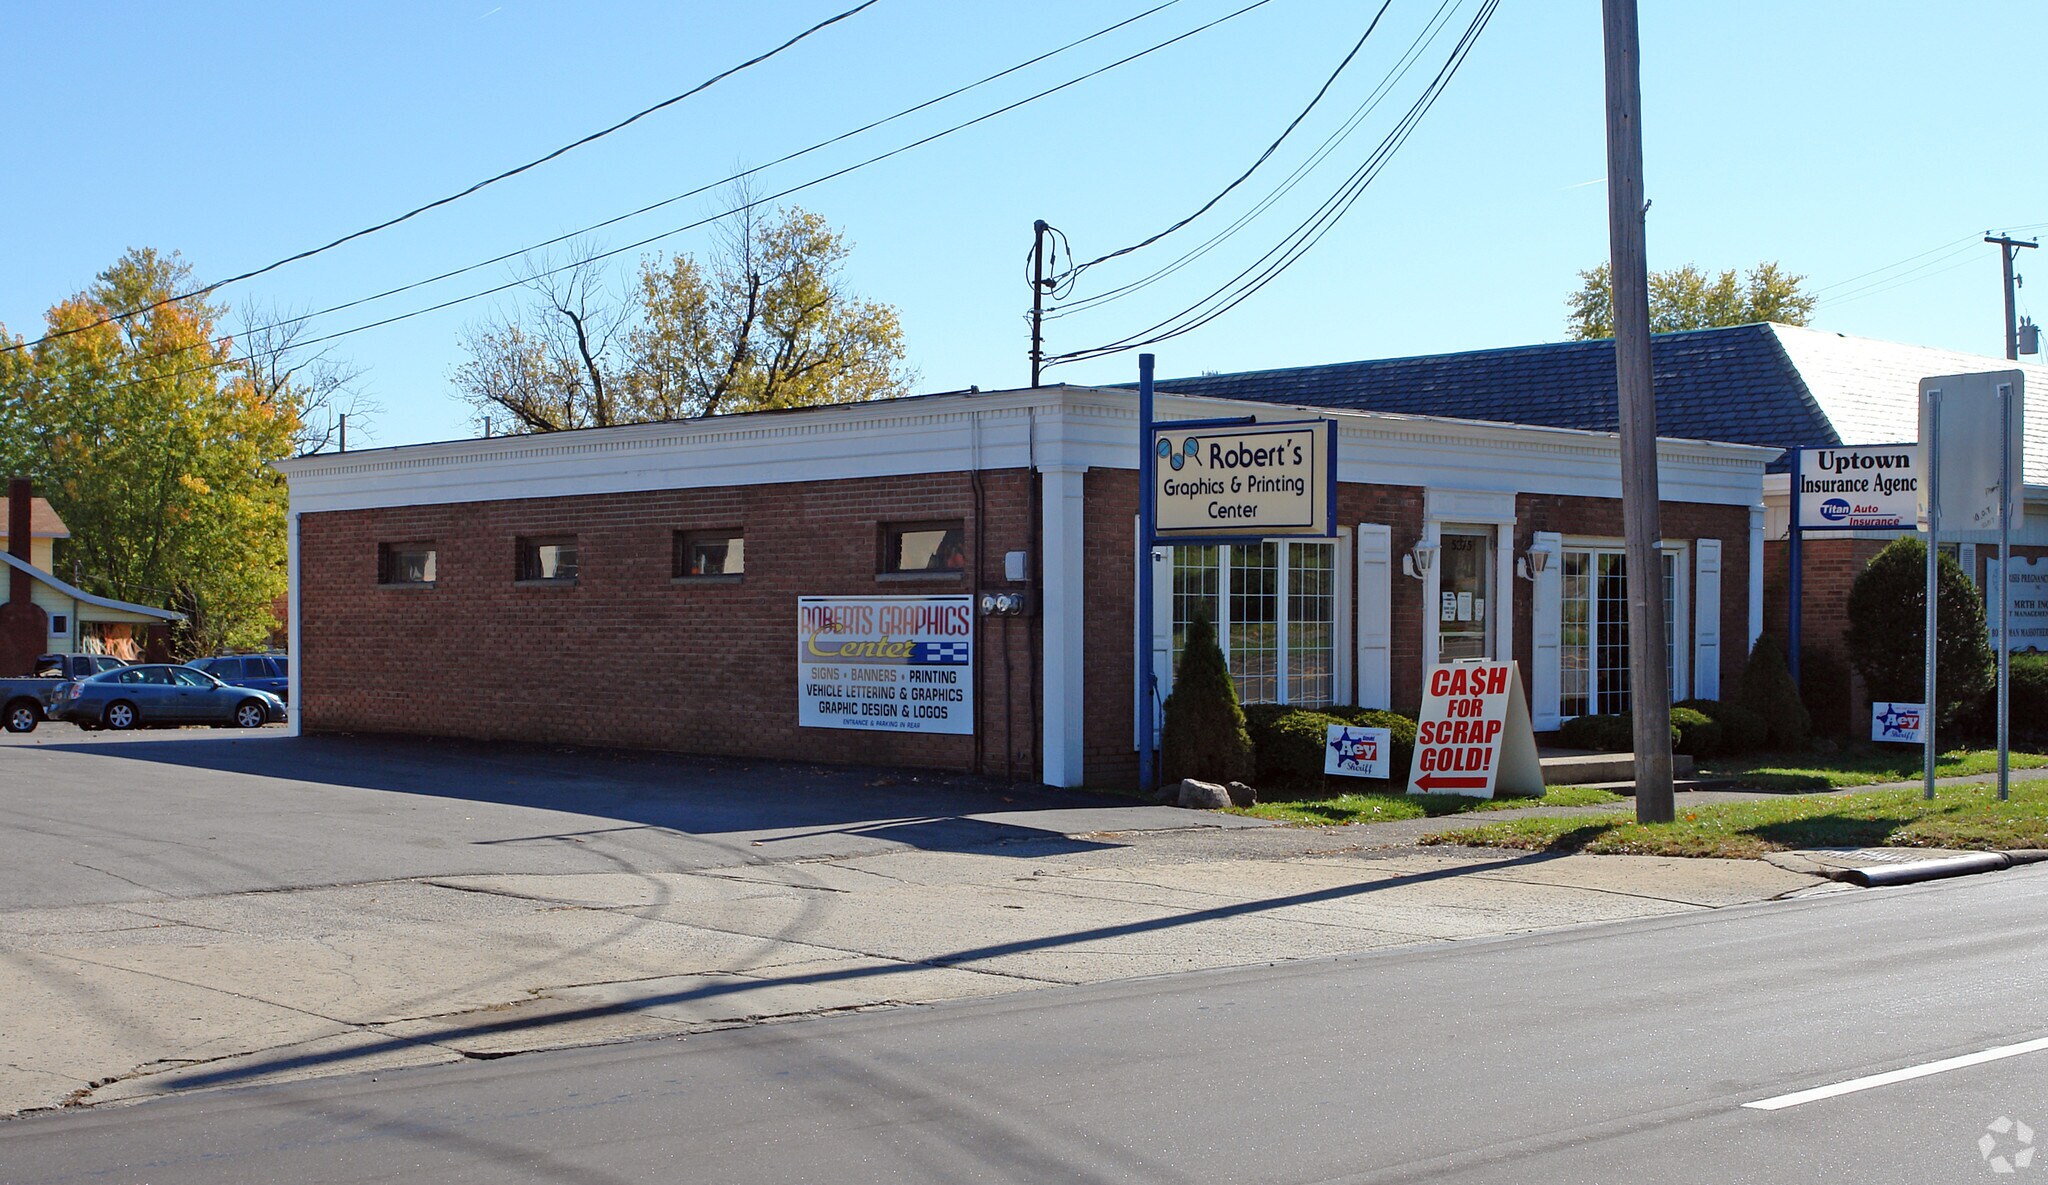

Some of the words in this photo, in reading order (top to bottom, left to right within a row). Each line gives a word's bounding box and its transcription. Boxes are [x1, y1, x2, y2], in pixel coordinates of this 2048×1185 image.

[1210, 439, 1303, 469] Robert's
[1818, 451, 1910, 474] Uptown
[1163, 478, 1225, 500] Graphics
[1230, 476, 1242, 493] &
[1248, 475, 1305, 496] Printing
[1800, 474, 1869, 495] Insurance
[1873, 472, 1918, 496] Agenc
[1208, 502, 1258, 519] Center
[1820, 505, 1850, 514] Titan
[1853, 505, 1879, 513] Auto
[1849, 517, 1900, 526] Insurance
[801, 605, 874, 635] ROBERTS
[879, 605, 970, 636] GRAPHICS
[807, 622, 917, 658] Center
[811, 667, 840, 680] SIGNS
[851, 668, 897, 682] BANNERS
[909, 670, 957, 684] PRINTING
[1430, 666, 1508, 698] CA$H
[806, 684, 842, 698] VEHICLE
[846, 685, 895, 699] LETTERING
[900, 687, 908, 700] &
[911, 687, 963, 702] GRAPHICS
[819, 701, 858, 715] GRAPHIC
[861, 703, 898, 717] DESIGN
[901, 705, 910, 719] &
[913, 705, 948, 719] LOGOS
[1447, 699, 1483, 718] FOR
[876, 720, 898, 728] PARKING
[1885, 714, 1919, 728] Aey
[1419, 720, 1502, 745] SCRAP
[1340, 740, 1376, 759] Aey
[1346, 762, 1372, 774] Sheriff
[1420, 747, 1492, 772] GOLD!
